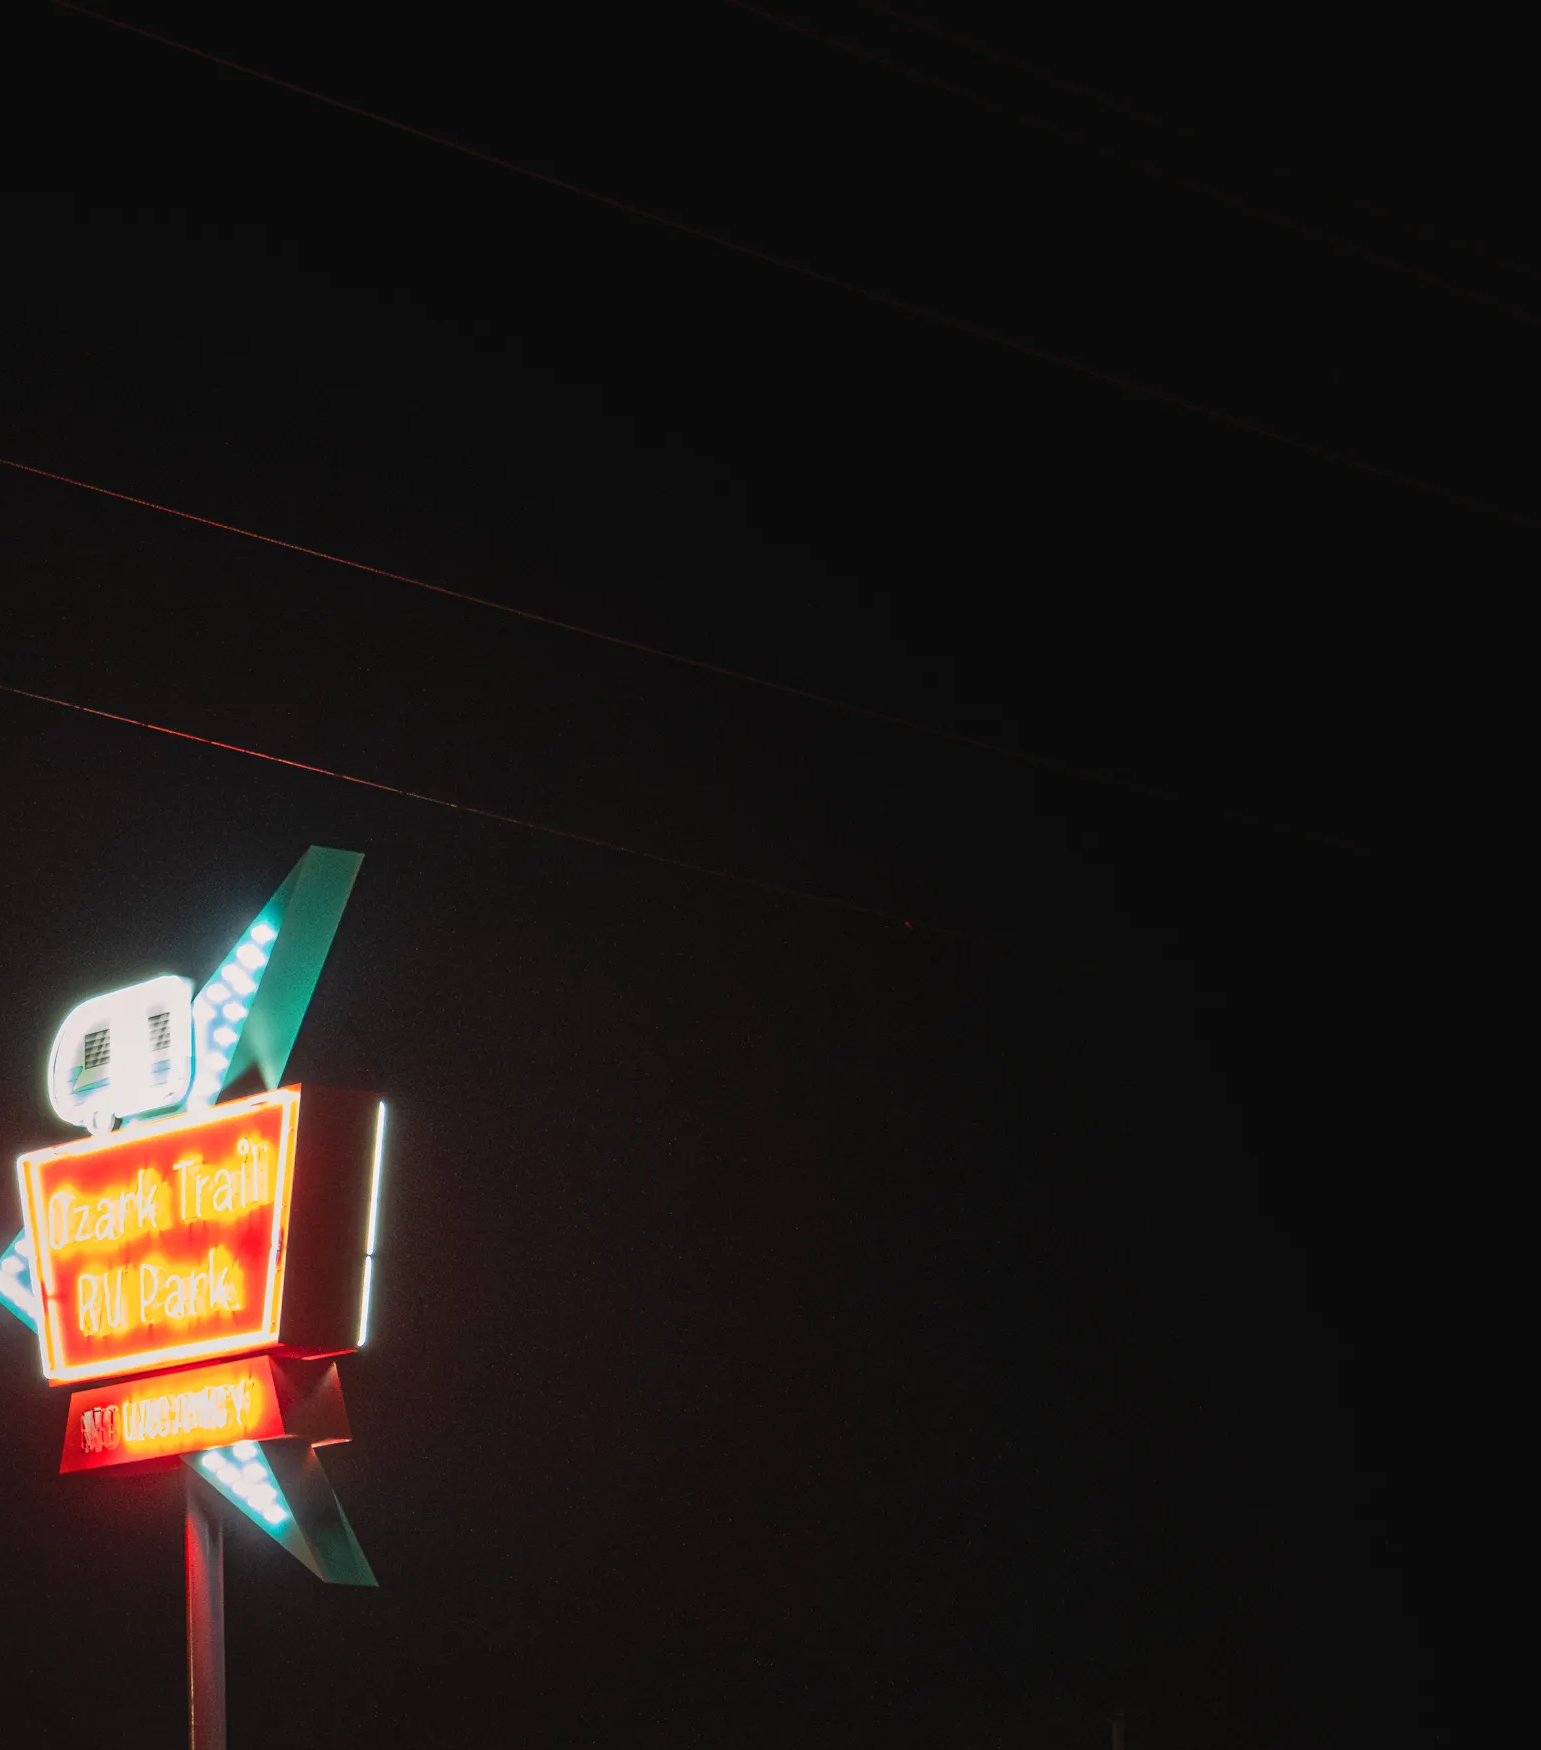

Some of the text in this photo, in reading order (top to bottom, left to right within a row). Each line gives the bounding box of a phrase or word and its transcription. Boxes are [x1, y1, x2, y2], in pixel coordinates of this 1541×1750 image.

[48, 1139, 264, 1250] Ozark Trail
[78, 1248, 232, 1333] RV Park
[122, 1379, 253, 1442] VACANCY
